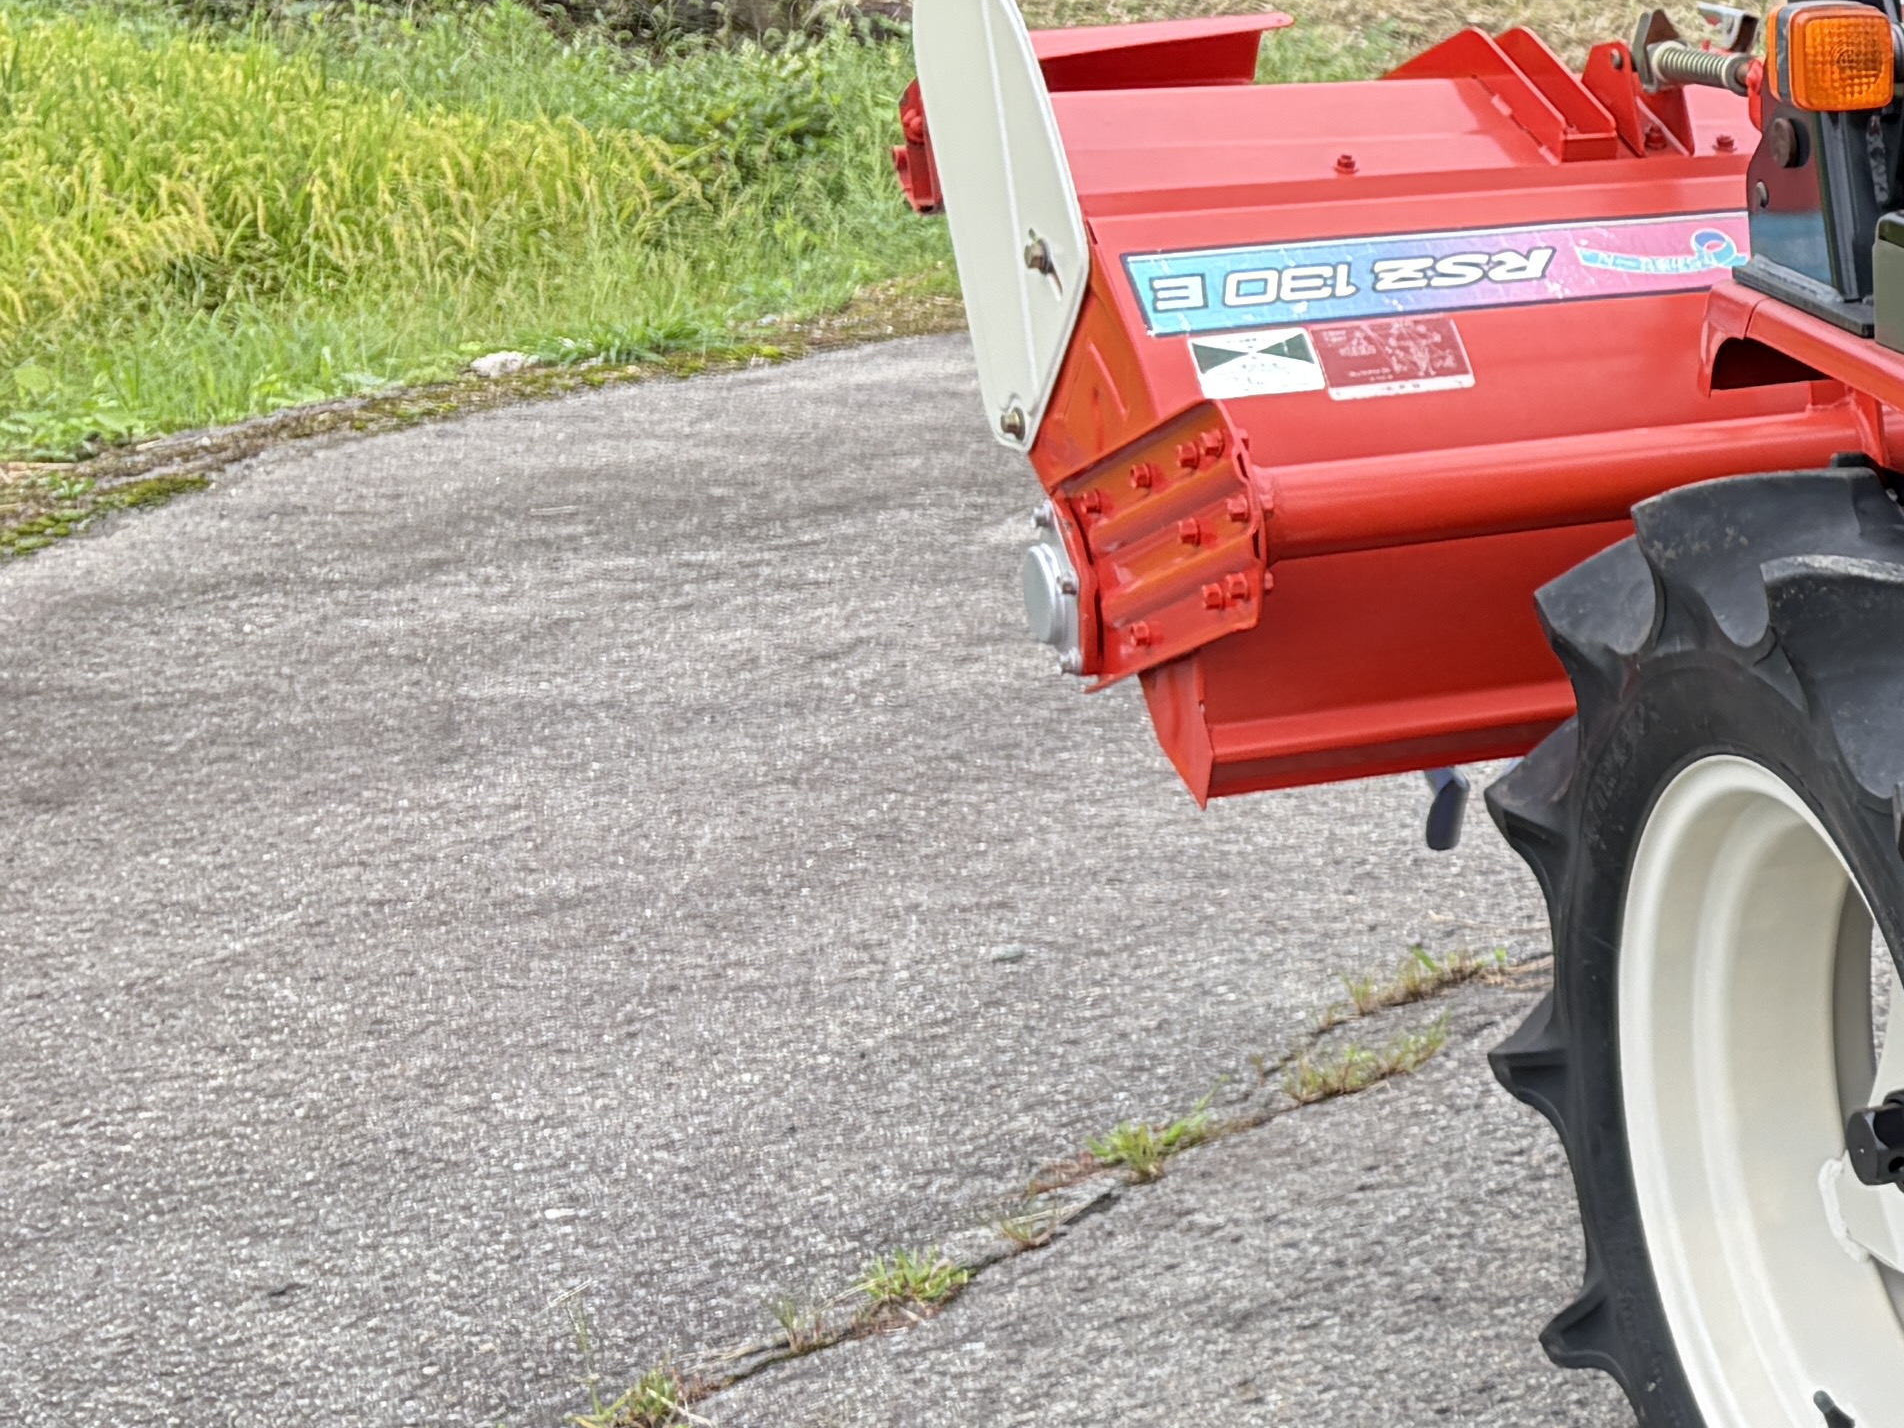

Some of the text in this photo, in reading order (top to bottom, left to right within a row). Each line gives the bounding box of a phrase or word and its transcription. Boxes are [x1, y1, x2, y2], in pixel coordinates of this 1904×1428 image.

[1151, 274, 1205, 311] E
[1224, 257, 1354, 306] 130
[1374, 245, 1553, 299] RSZ
